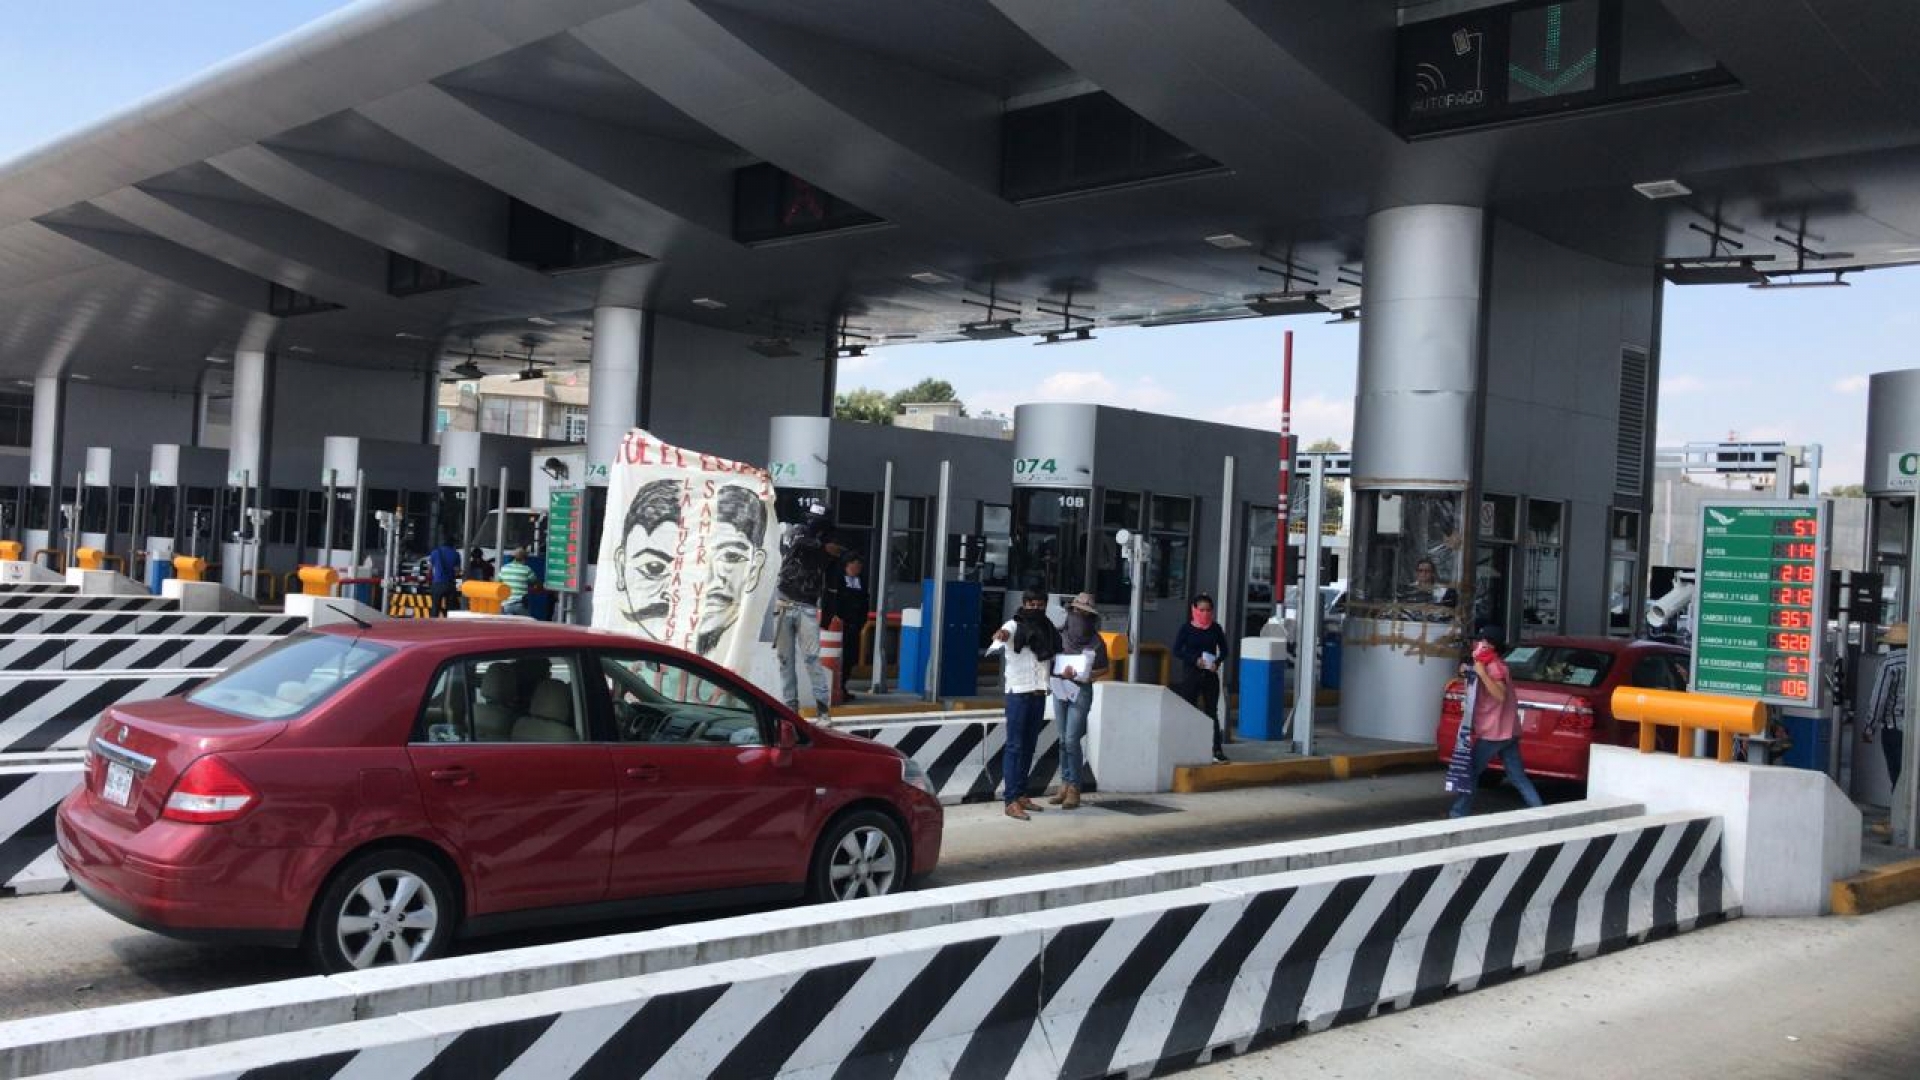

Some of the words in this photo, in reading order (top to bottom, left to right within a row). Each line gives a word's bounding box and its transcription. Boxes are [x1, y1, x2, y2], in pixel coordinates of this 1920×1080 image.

[586, 464, 607, 477] 74
[1016, 459, 1057, 474] 074
[696, 480, 715, 565] SAMIR
[1794, 519, 1816, 536] 57
[1780, 611, 1812, 628] 357
[1778, 632, 1810, 650] 528
[1787, 656, 1809, 673] 57
[1782, 680, 1807, 697] 106
